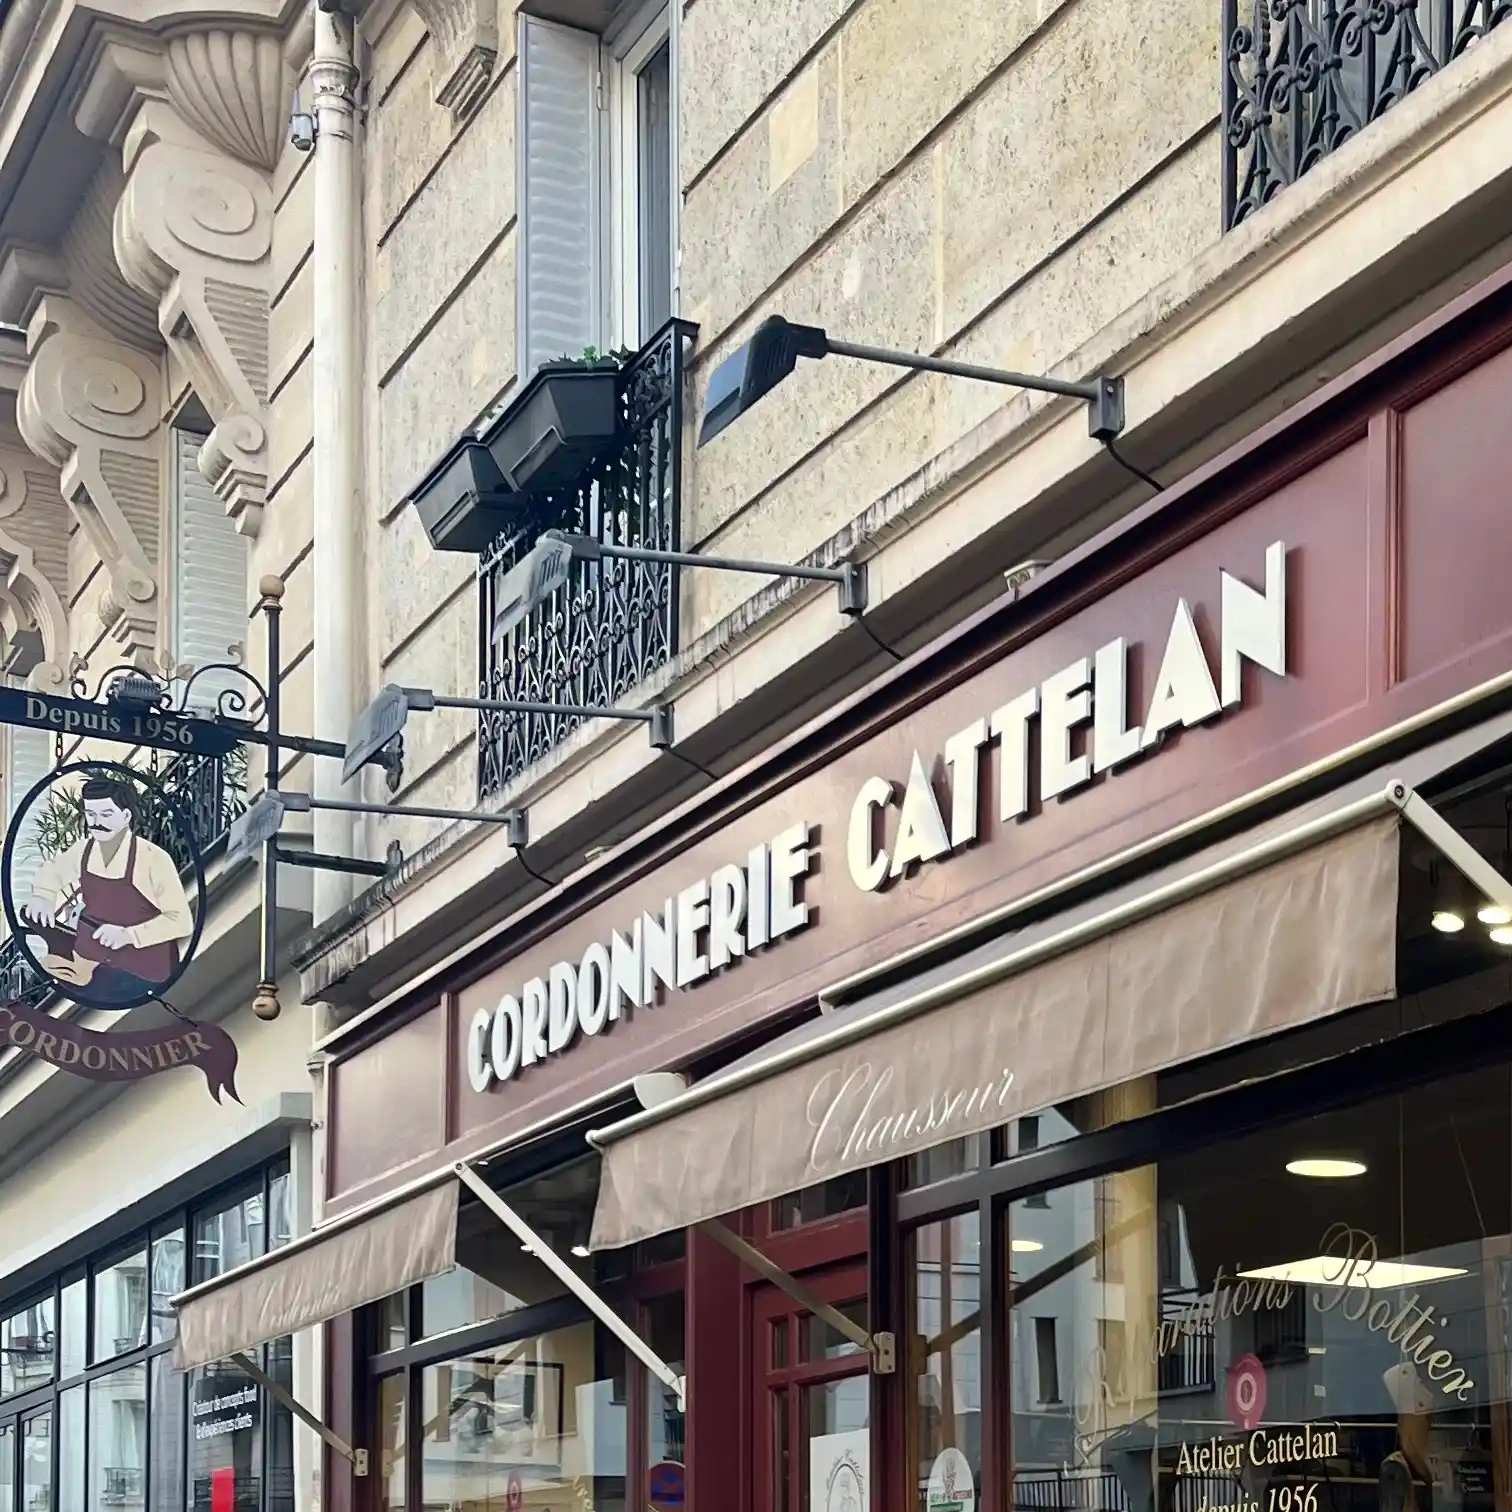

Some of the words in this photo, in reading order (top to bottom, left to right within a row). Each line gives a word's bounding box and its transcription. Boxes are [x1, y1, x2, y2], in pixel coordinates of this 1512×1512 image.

[26, 697, 121, 734] Depuis
[133, 707, 194, 746] 1956
[467, 820, 810, 1093] CORDONNERIE
[847, 539, 1286, 892] CATTELAN
[805, 1062, 1014, 1173] Chausseur
[1313, 1221, 1474, 1401] Bottier
[1176, 1435, 1244, 1475] Atelier
[1249, 1423, 1338, 1466] Cattelan
